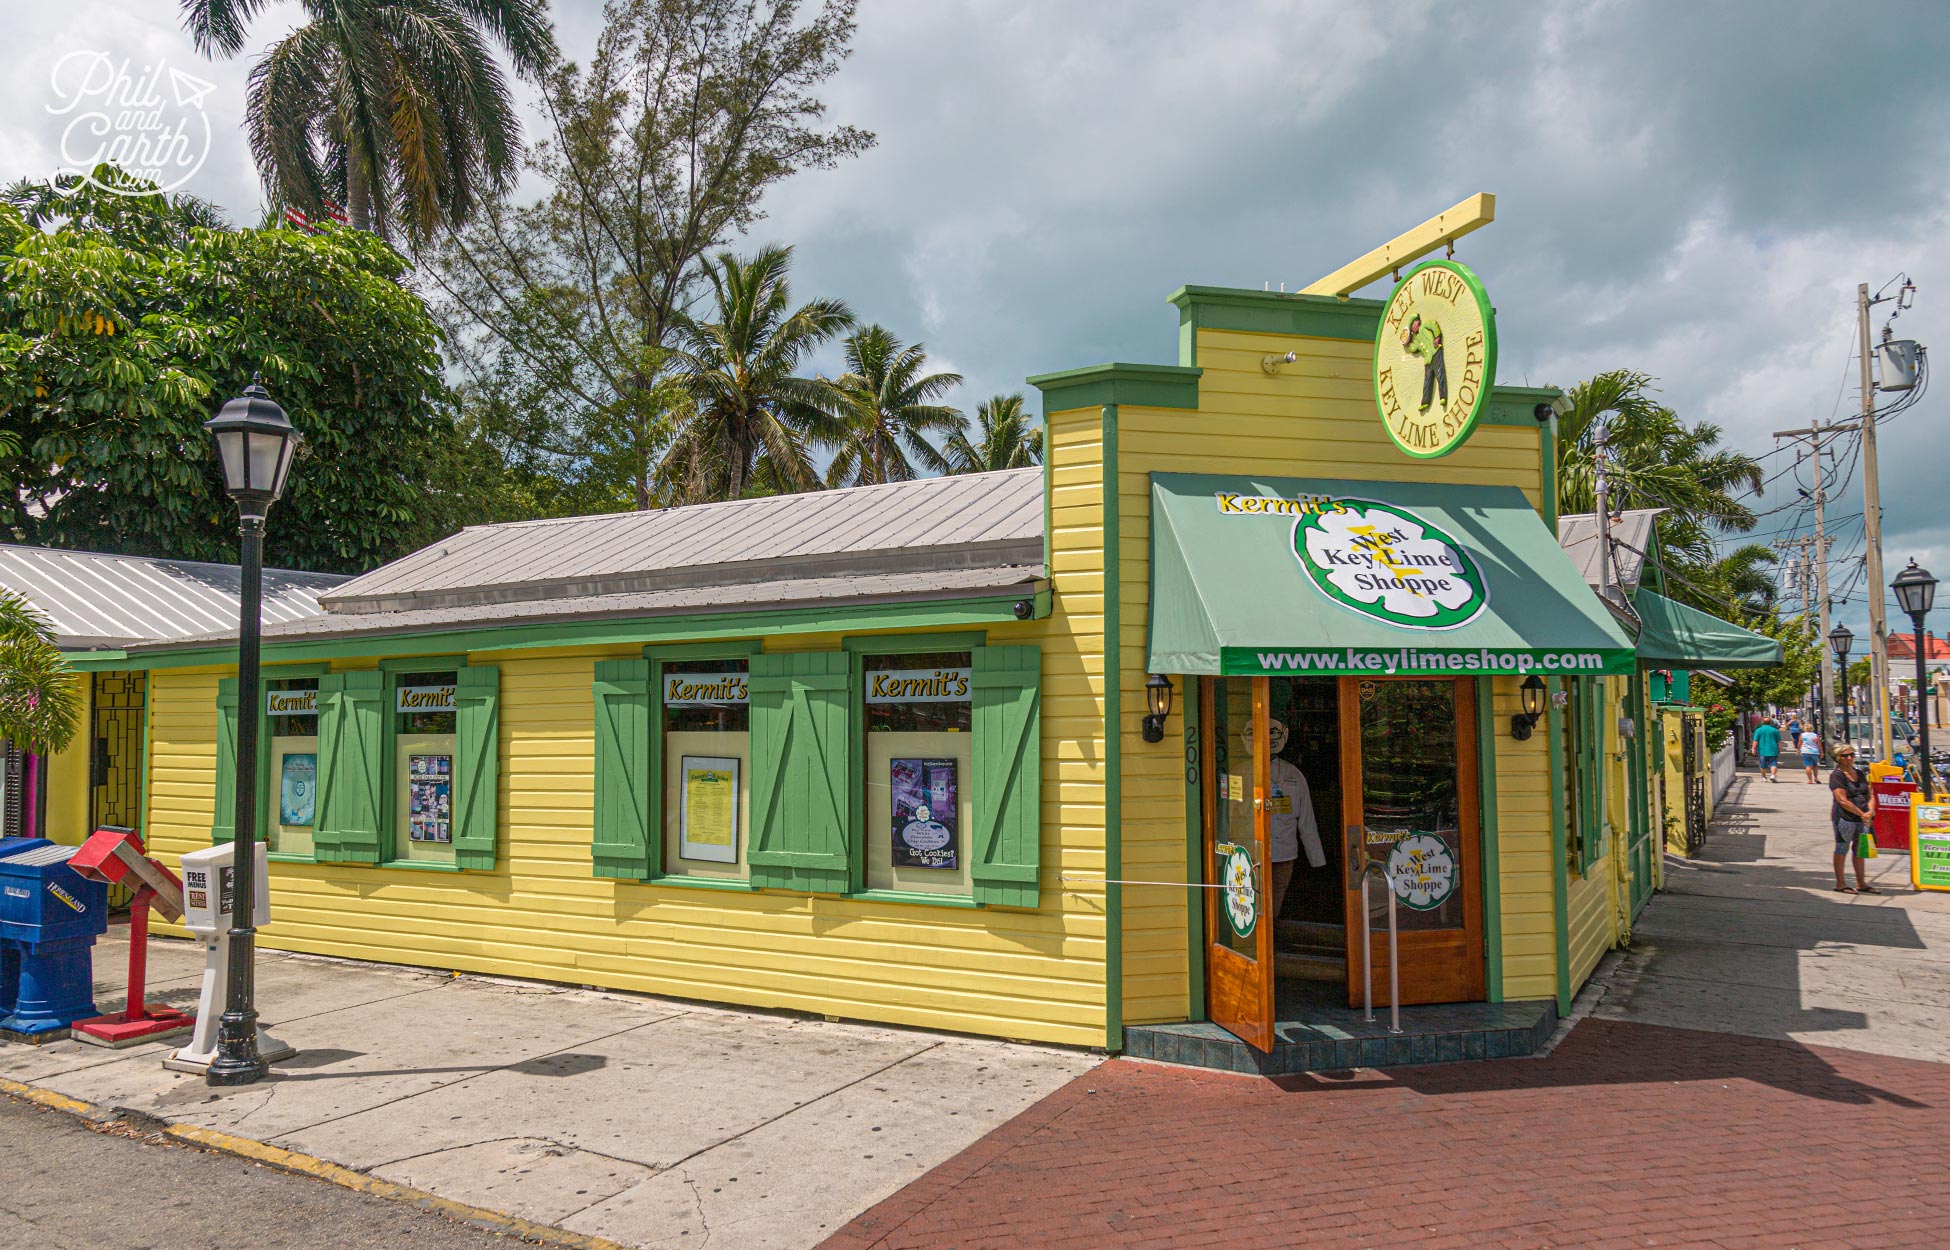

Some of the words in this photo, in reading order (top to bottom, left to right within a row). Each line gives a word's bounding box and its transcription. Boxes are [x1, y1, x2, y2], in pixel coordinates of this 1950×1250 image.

[1387, 281, 1414, 335] KEY
[1421, 270, 1465, 306] WEST
[1380, 366, 1401, 420] KEY
[1397, 416, 1439, 448] LIME
[1442, 331, 1483, 438] SHOPPE
[1219, 493, 1348, 516] Kermit's
[1349, 527, 1410, 552] West
[1321, 548, 1373, 569] Key
[1382, 549, 1453, 567] Lime
[1354, 573, 1453, 596] Shoppe
[1257, 648, 1604, 674] www.keylimeshop.com
[669, 676, 748, 700] Kermit's
[871, 671, 969, 698] Kermit's
[909, 848, 922, 857] Got
[924, 849, 955, 858] Cookies?
[1409, 848, 1436, 865] West
[187, 872, 206, 882] FREE
[1396, 864, 1418, 877] Key
[1420, 863, 1447, 873] Lime
[188, 881, 207, 889] MENUS
[1403, 880, 1442, 892] Shoppe
